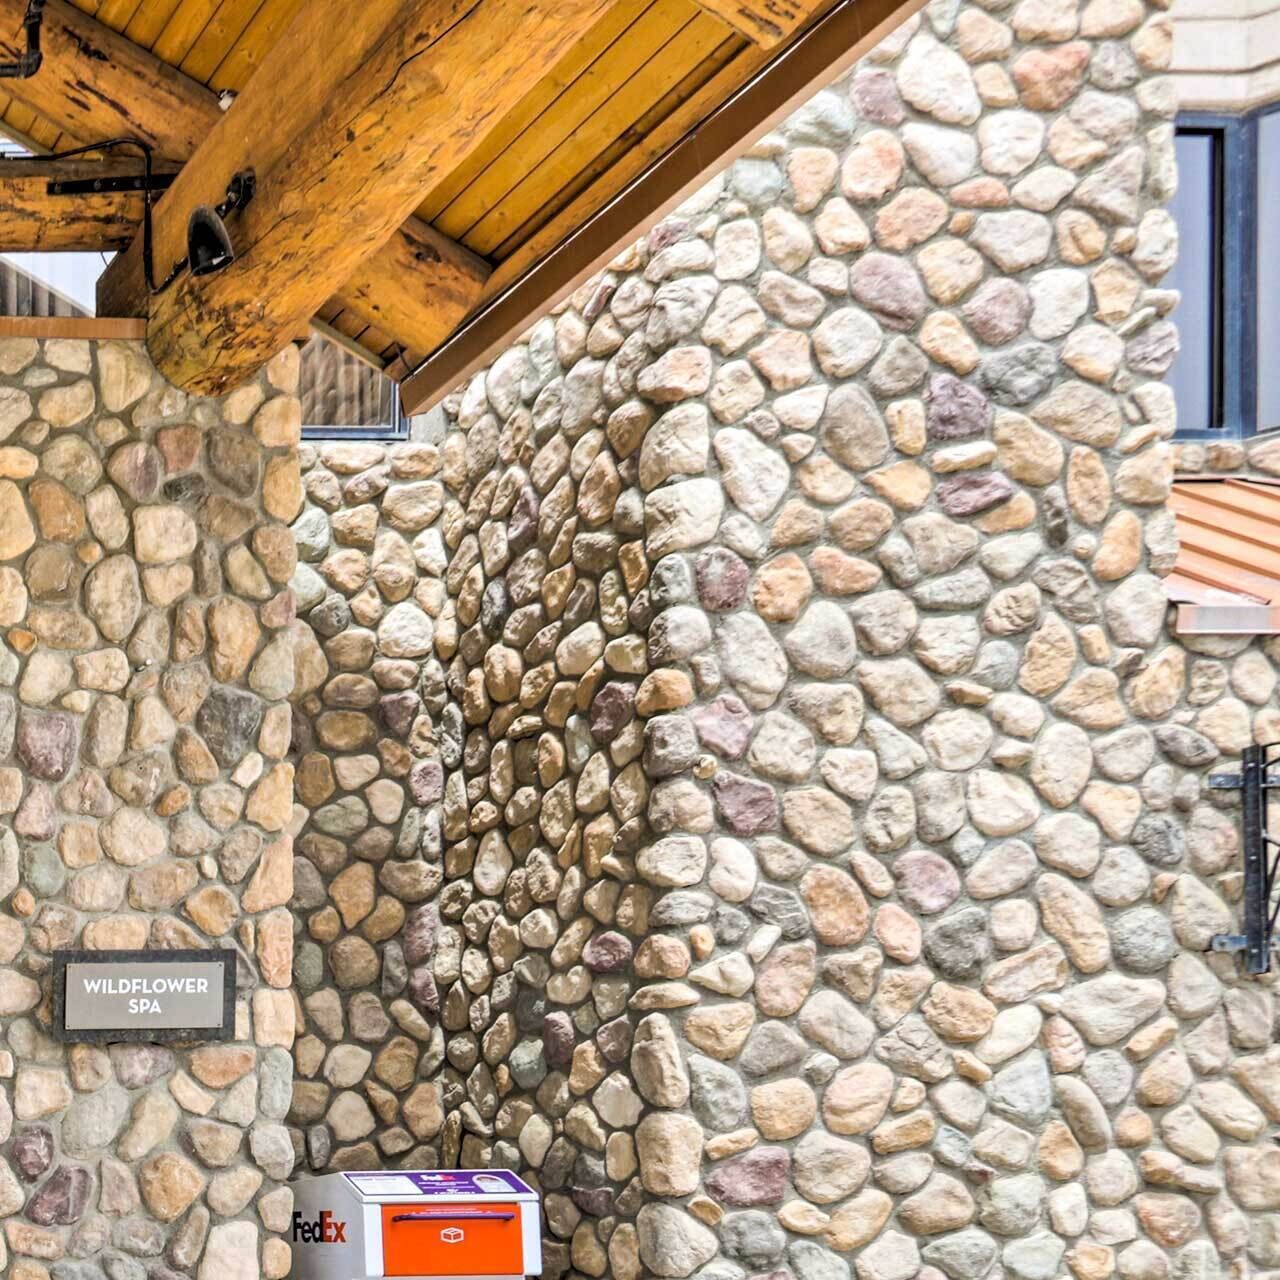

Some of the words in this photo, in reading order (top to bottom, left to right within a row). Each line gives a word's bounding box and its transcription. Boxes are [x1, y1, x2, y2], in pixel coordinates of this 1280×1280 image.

[83, 978, 208, 994] WILDFLOWER
[128, 998, 162, 1014] SPA
[293, 1210, 346, 1243] FedEx
